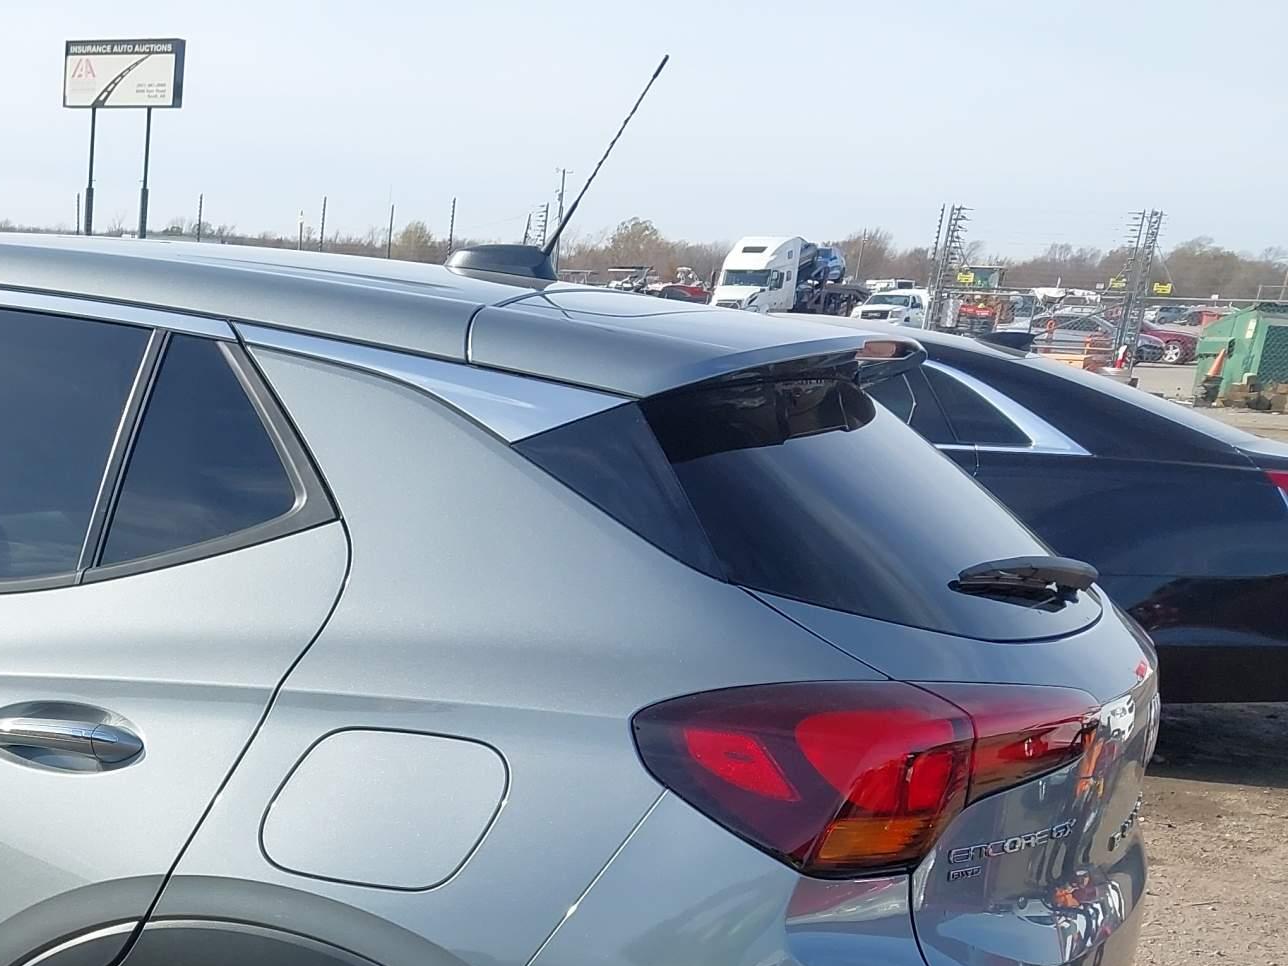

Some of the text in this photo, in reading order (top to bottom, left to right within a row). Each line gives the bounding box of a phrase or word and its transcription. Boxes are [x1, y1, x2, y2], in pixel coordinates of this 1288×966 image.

[70, 43, 173, 54] INSURANCE AUTO AUCTIONS
[948, 828, 1050, 864] ENCORE
